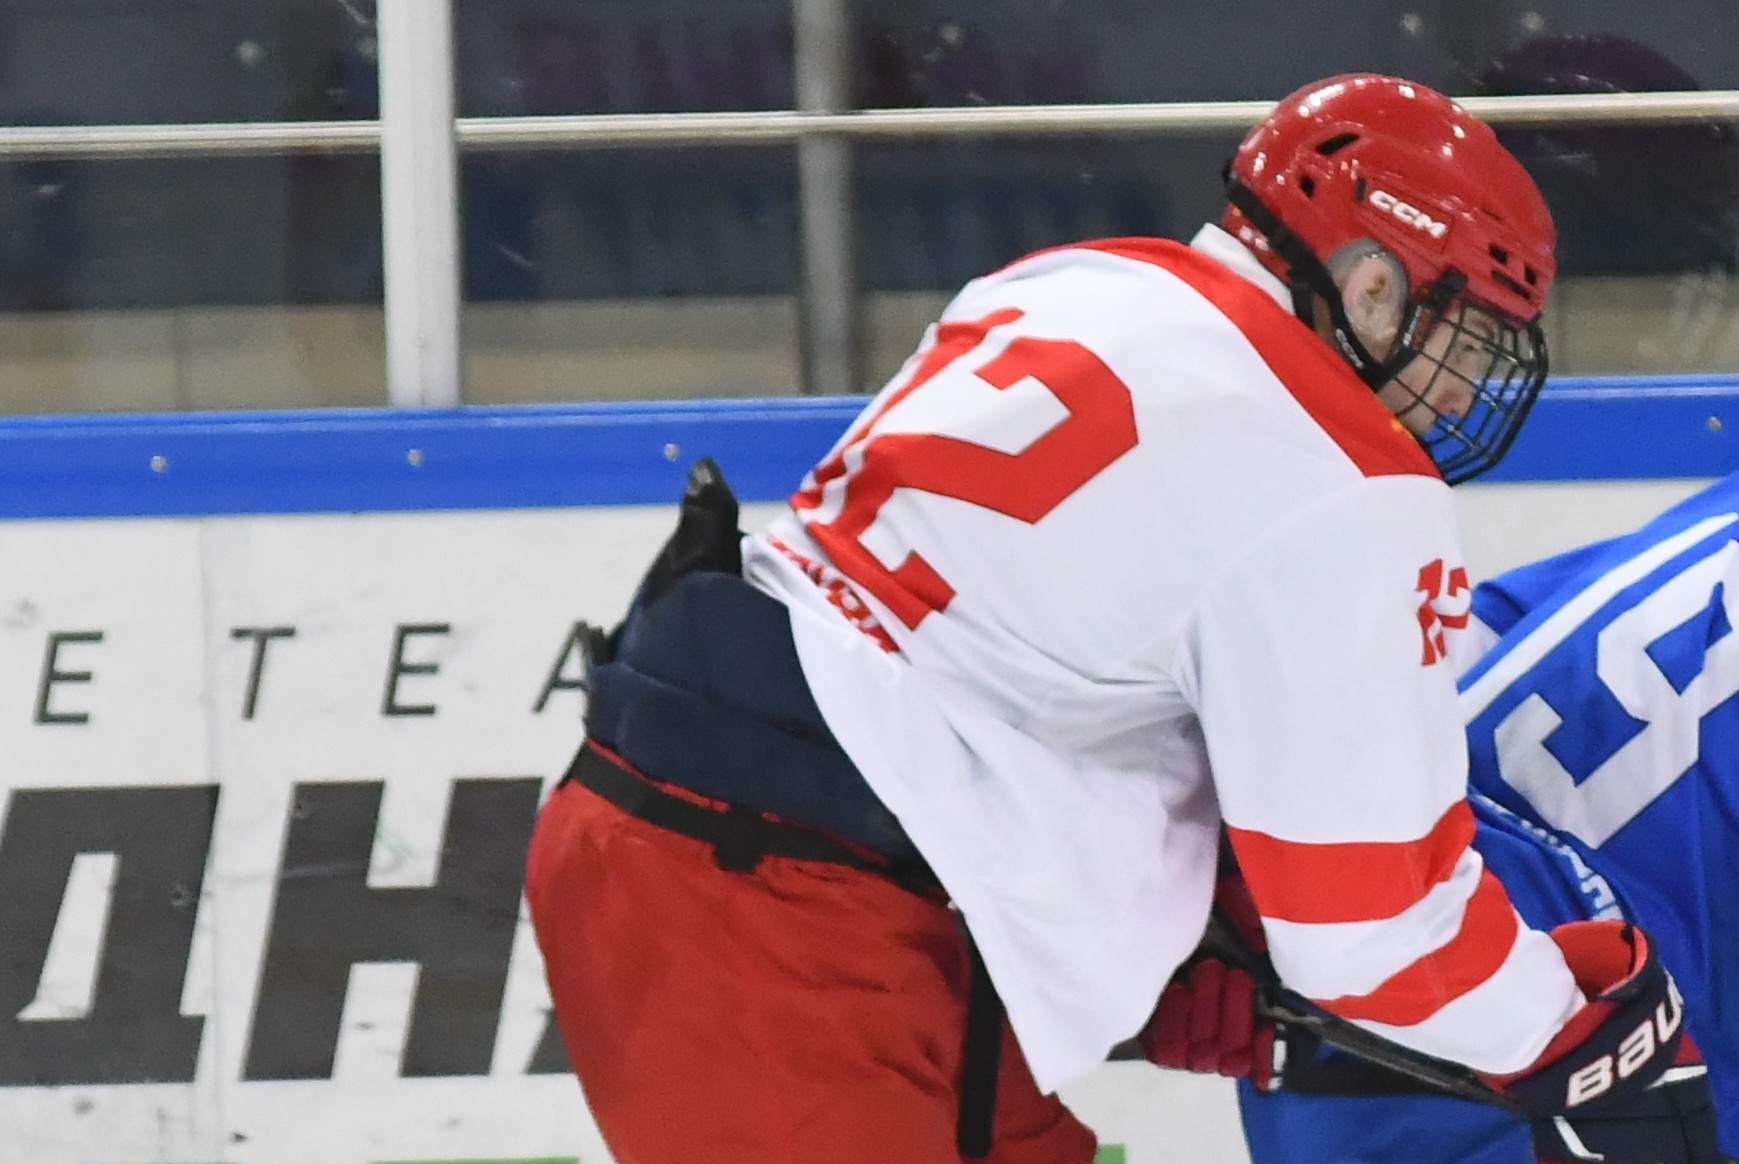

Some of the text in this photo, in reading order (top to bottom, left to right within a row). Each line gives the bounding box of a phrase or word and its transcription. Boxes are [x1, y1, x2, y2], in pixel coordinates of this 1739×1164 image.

[1369, 190, 1447, 238] CCM
[789, 306, 1140, 632] 12
[1415, 557, 1472, 666] 12
[229, 619, 592, 722] TEA
[0, 776, 583, 1088] ДН
